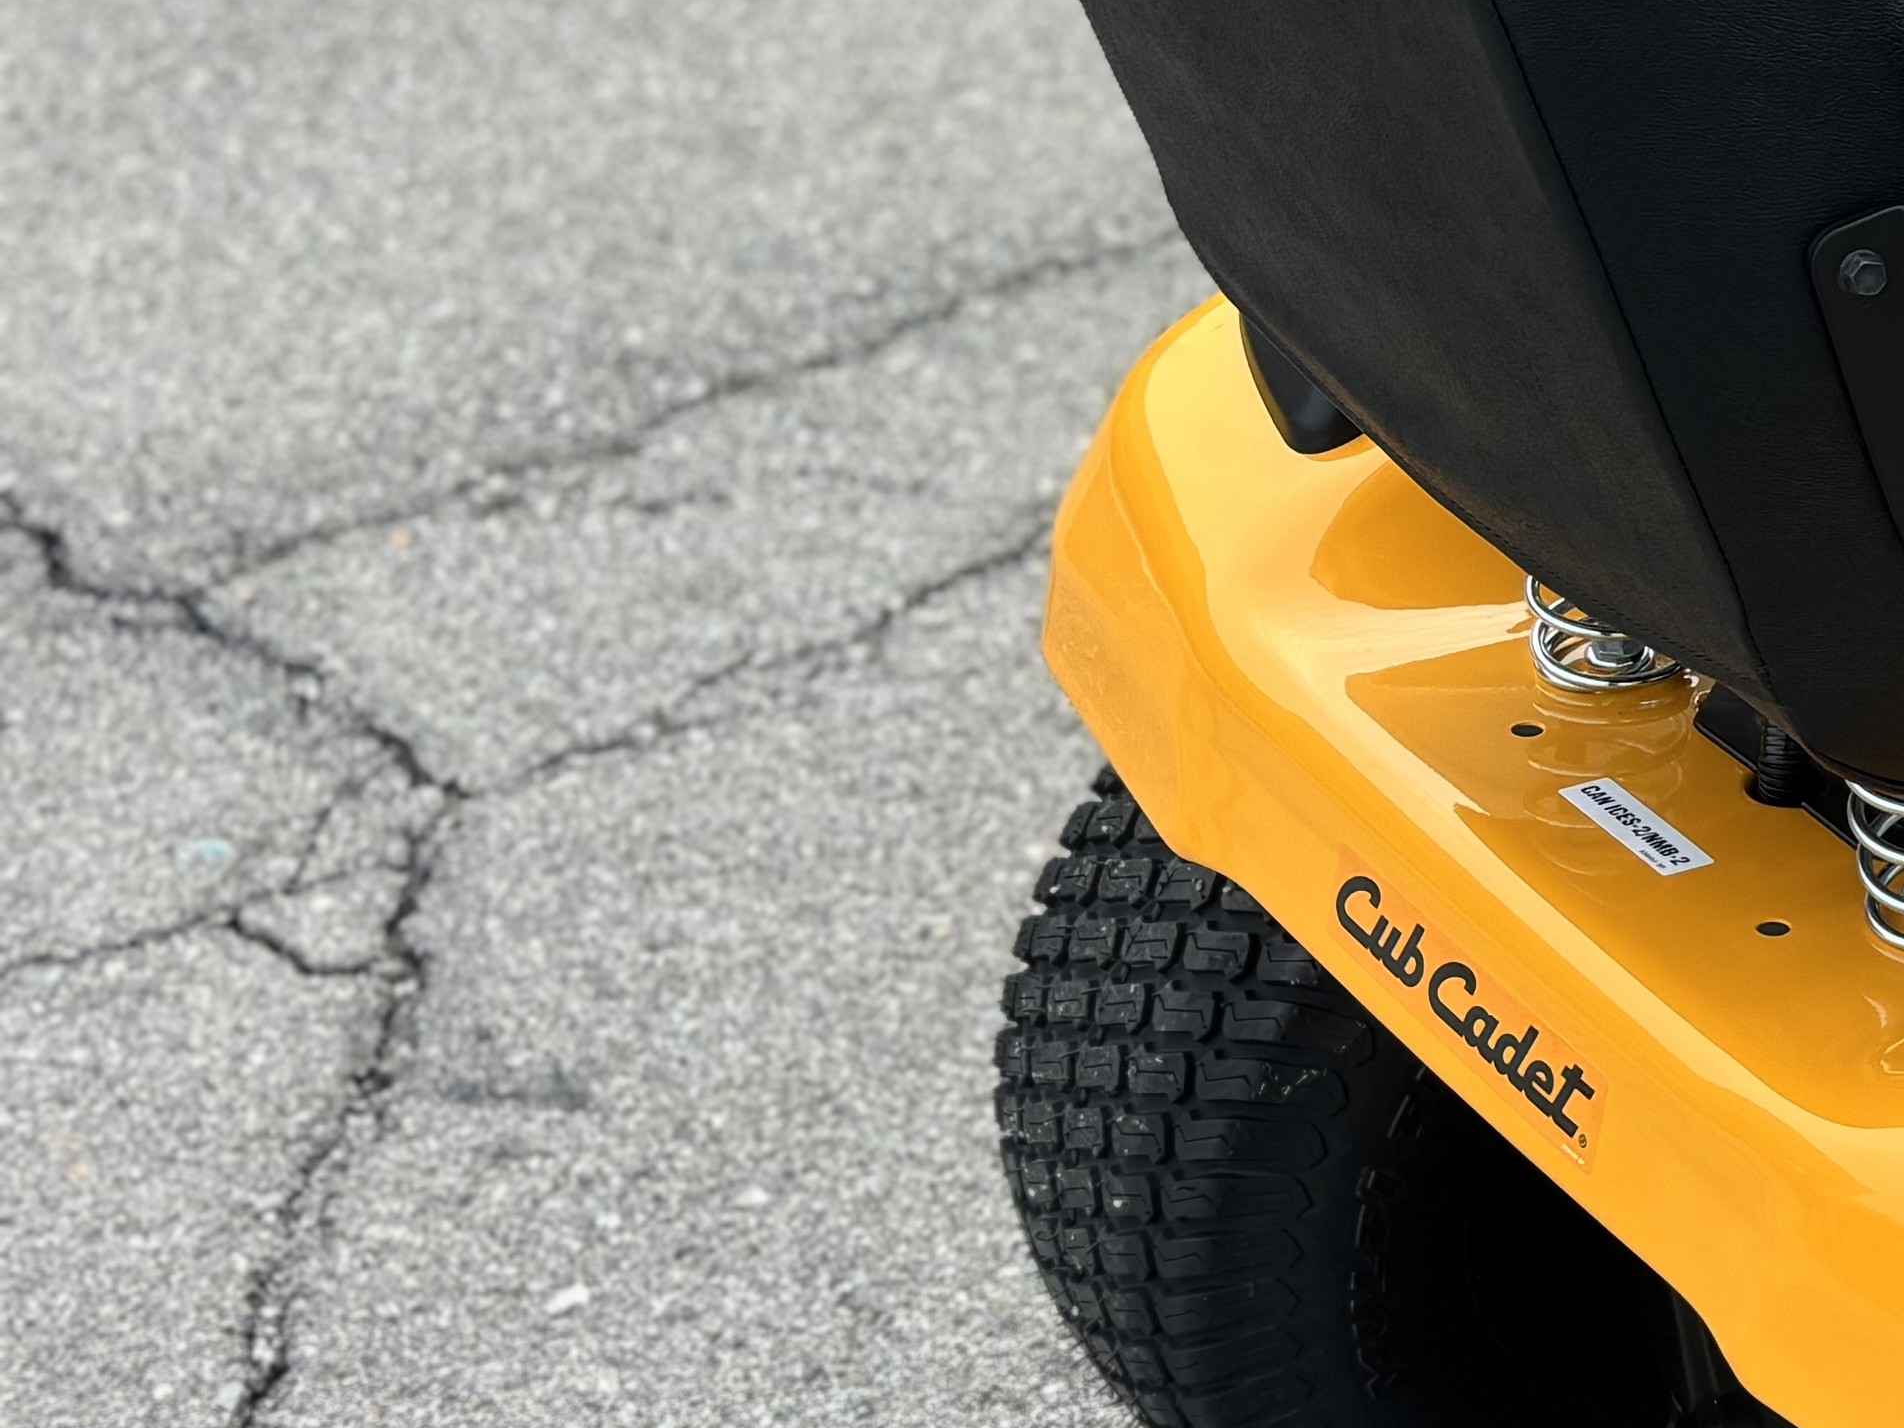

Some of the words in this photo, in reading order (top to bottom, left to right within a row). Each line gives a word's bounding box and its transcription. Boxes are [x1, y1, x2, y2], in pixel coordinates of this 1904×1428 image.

[1580, 784, 1616, 806] CAN
[1603, 803, 1692, 866] ICES-2/NMB-2
[1335, 875, 1425, 988] Cub
[1427, 960, 1596, 1138] Cadet
